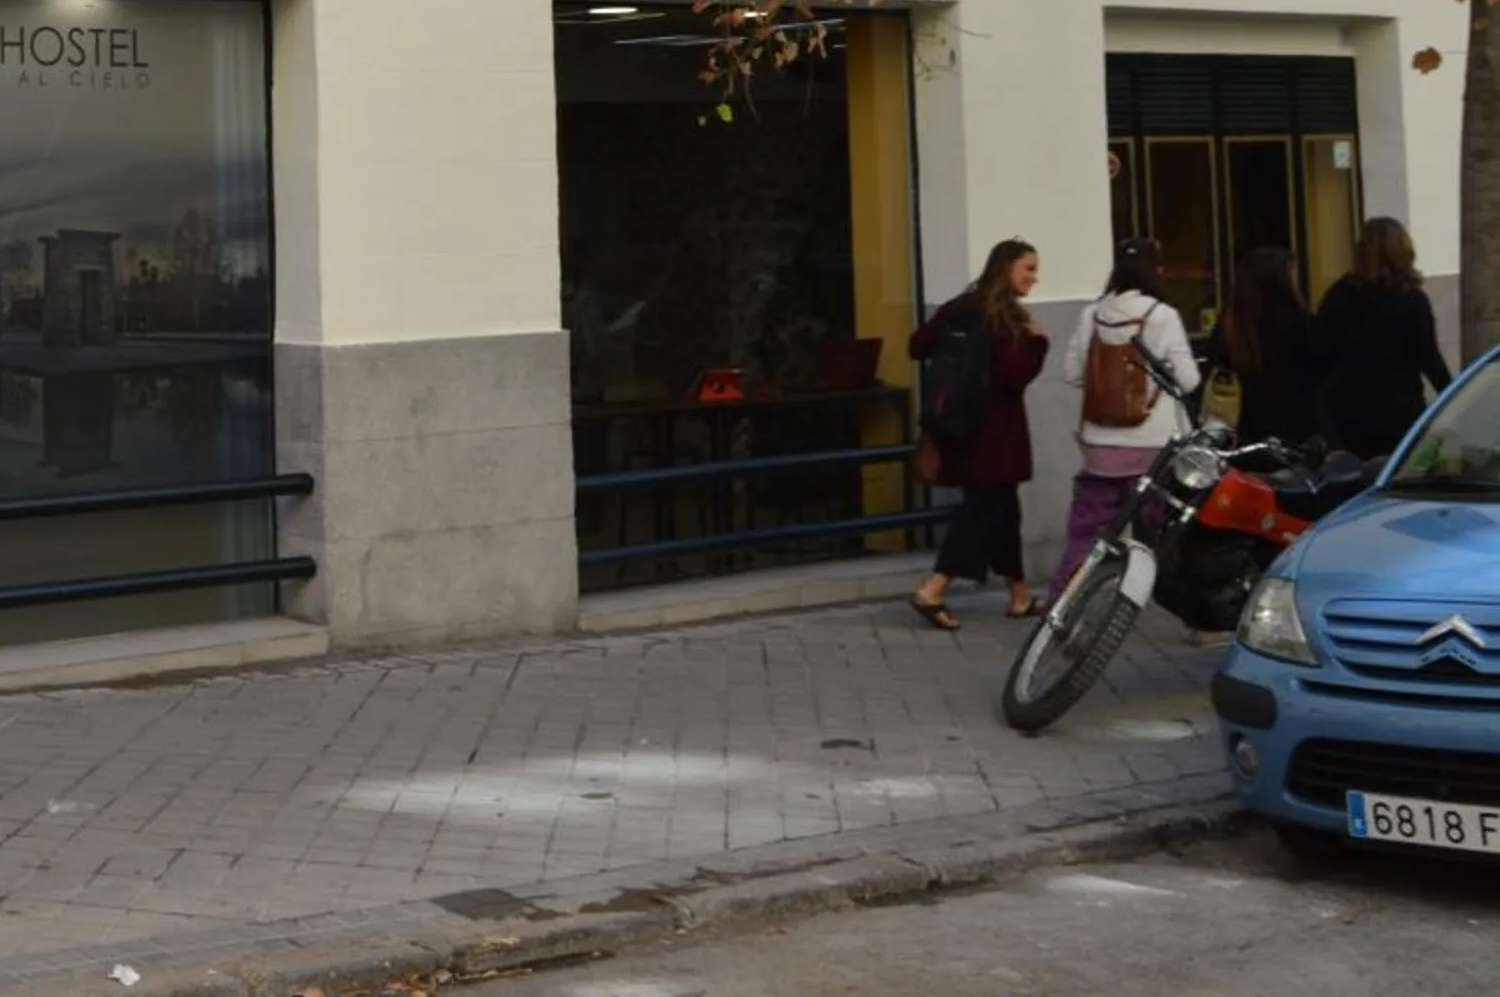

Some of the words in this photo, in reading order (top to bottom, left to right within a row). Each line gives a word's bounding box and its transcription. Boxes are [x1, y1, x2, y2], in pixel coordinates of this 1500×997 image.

[0, 26, 149, 68] HOSTEL
[18, 70, 49, 89] AL
[69, 70, 150, 90] CIELO
[1372, 802, 1466, 844] 6818
[1479, 812, 1500, 846] F
